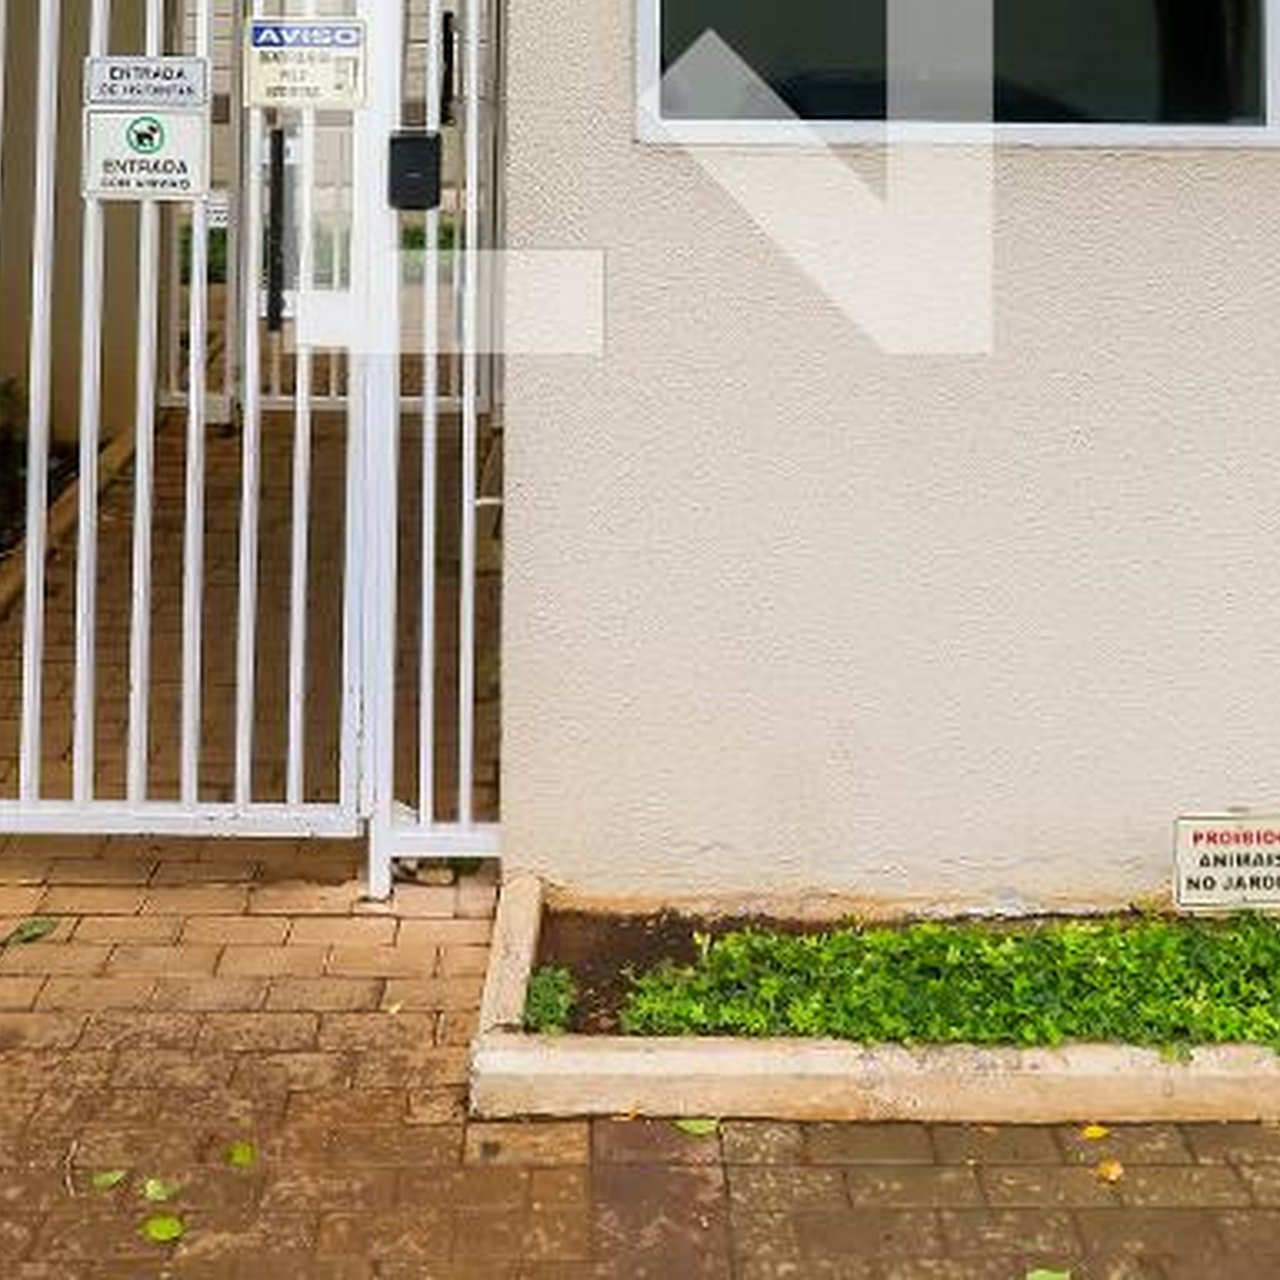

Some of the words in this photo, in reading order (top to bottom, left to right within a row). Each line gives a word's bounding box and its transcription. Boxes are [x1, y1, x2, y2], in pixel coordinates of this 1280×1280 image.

[256, 28, 358, 45] AVISO
[109, 66, 188, 81] ENTRADA
[102, 160, 188, 175] ENTRADA
[1186, 876, 1217, 891] NO
